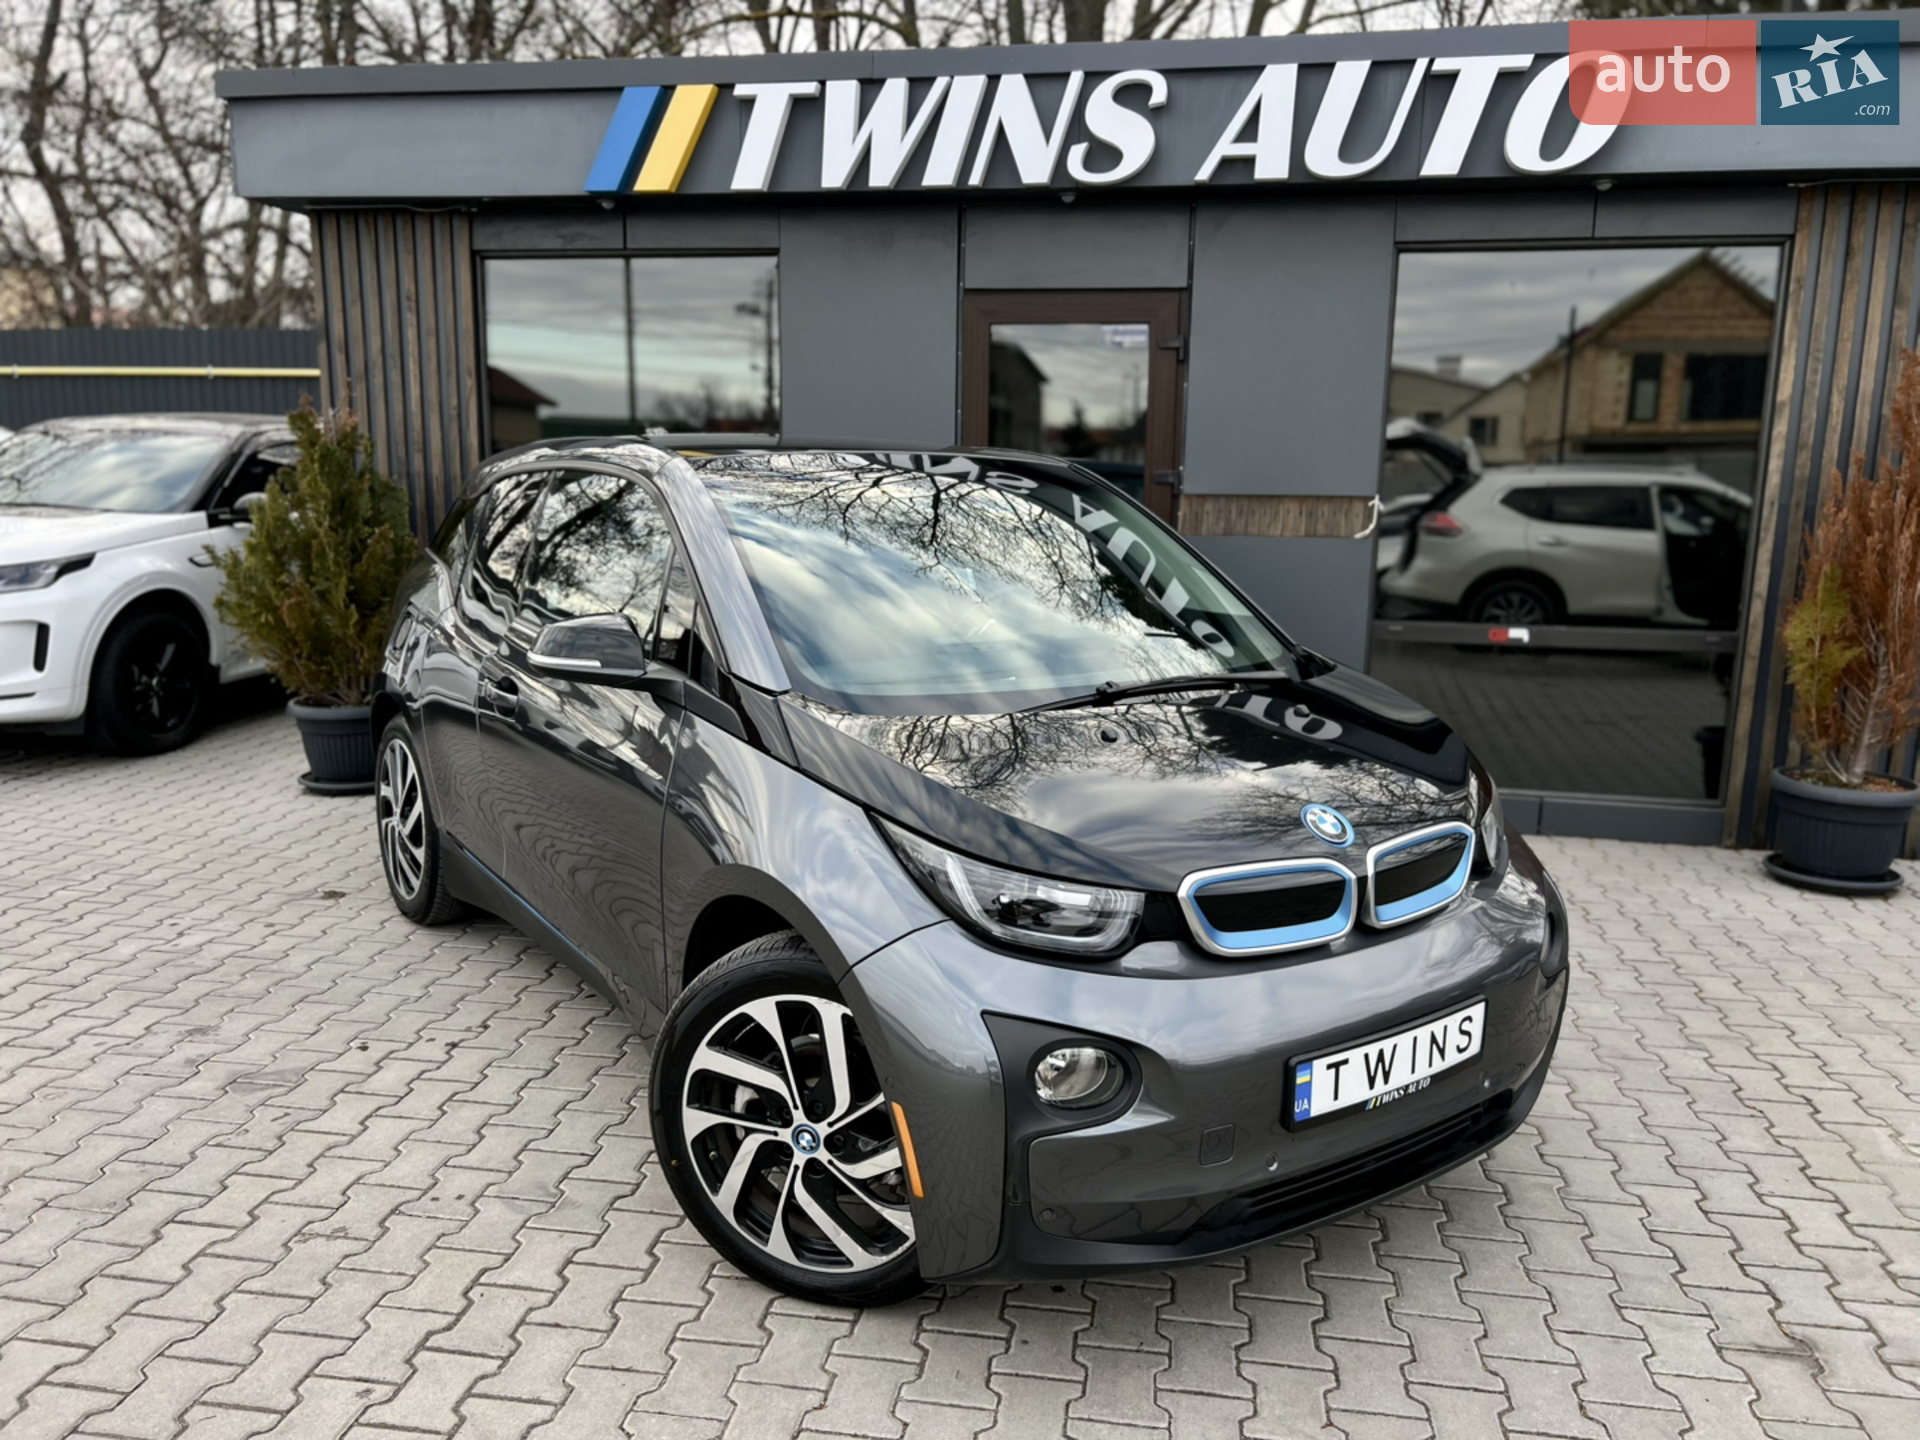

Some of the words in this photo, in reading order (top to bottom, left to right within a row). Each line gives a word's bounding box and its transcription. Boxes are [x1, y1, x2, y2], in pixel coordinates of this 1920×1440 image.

[730, 69, 1169, 192] TWINS
[1193, 49, 1634, 184] AUTO
[1326, 1015, 1473, 1102] TWINS
[1294, 1098, 1310, 1113] UA
[1376, 1087, 1406, 1107] TWINS
[1406, 1076, 1432, 1094] AUTO
